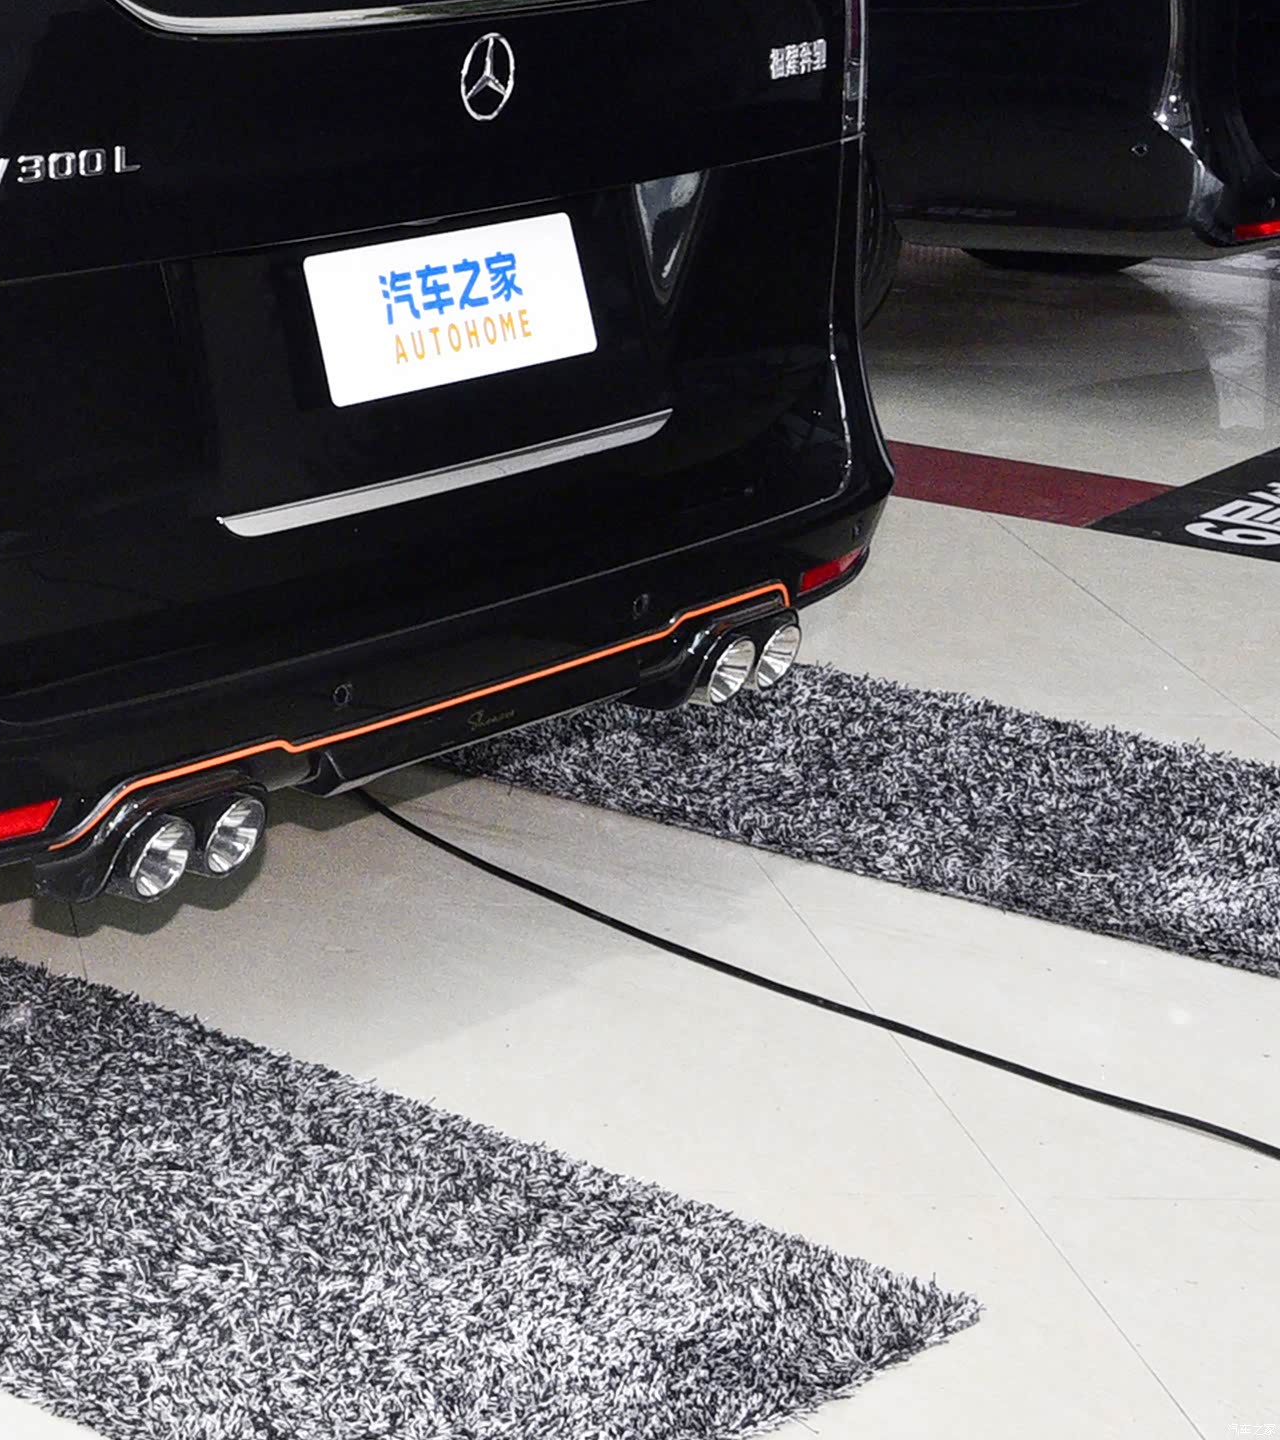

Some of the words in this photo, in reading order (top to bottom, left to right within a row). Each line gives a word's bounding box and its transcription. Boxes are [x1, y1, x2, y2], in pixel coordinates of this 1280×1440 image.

[378, 251, 524, 326] 汽车之家
[395, 309, 533, 365] AUTOHOME
